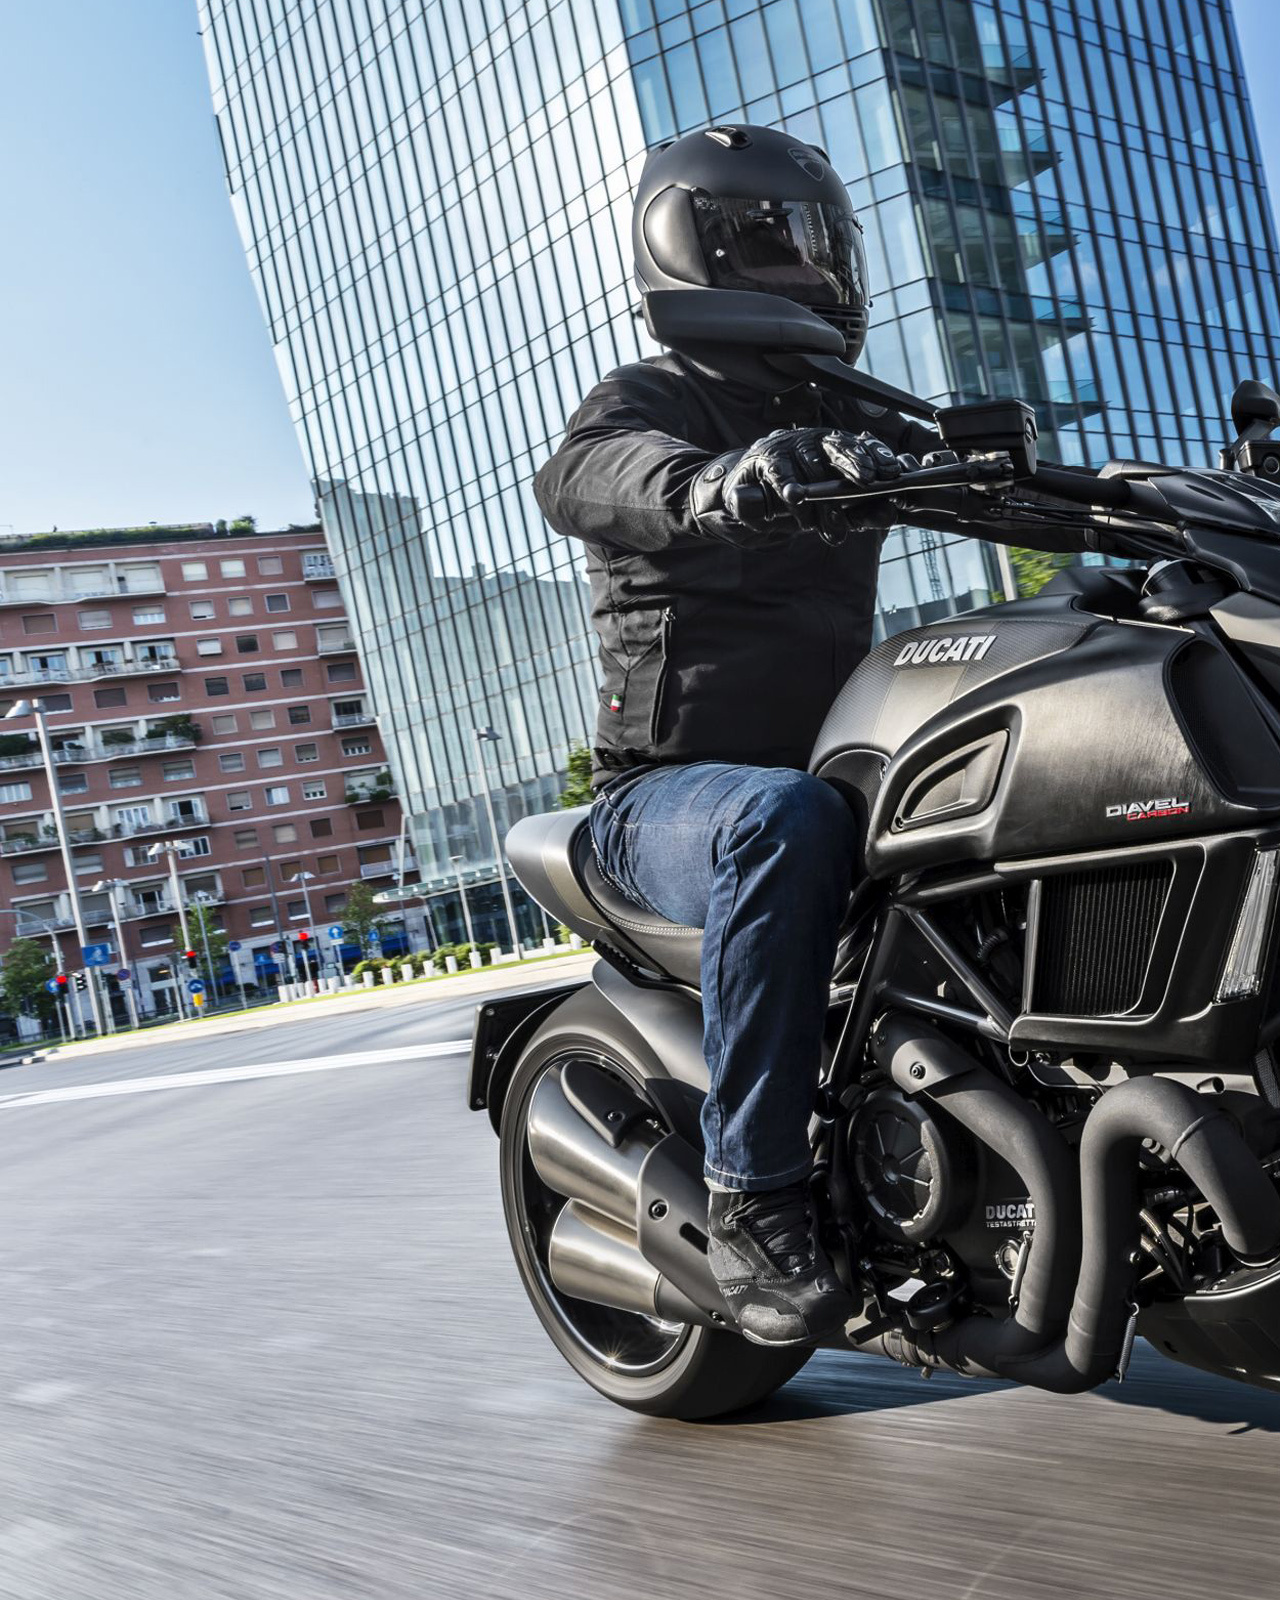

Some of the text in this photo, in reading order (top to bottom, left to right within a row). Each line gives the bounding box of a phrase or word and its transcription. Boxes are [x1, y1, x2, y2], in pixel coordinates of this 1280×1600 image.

[893, 635, 997, 666] DUCATI
[1105, 797, 1189, 817] DIAVEL
[1127, 806, 1189, 821] CARBON
[985, 1203, 1035, 1219] DUCAT
